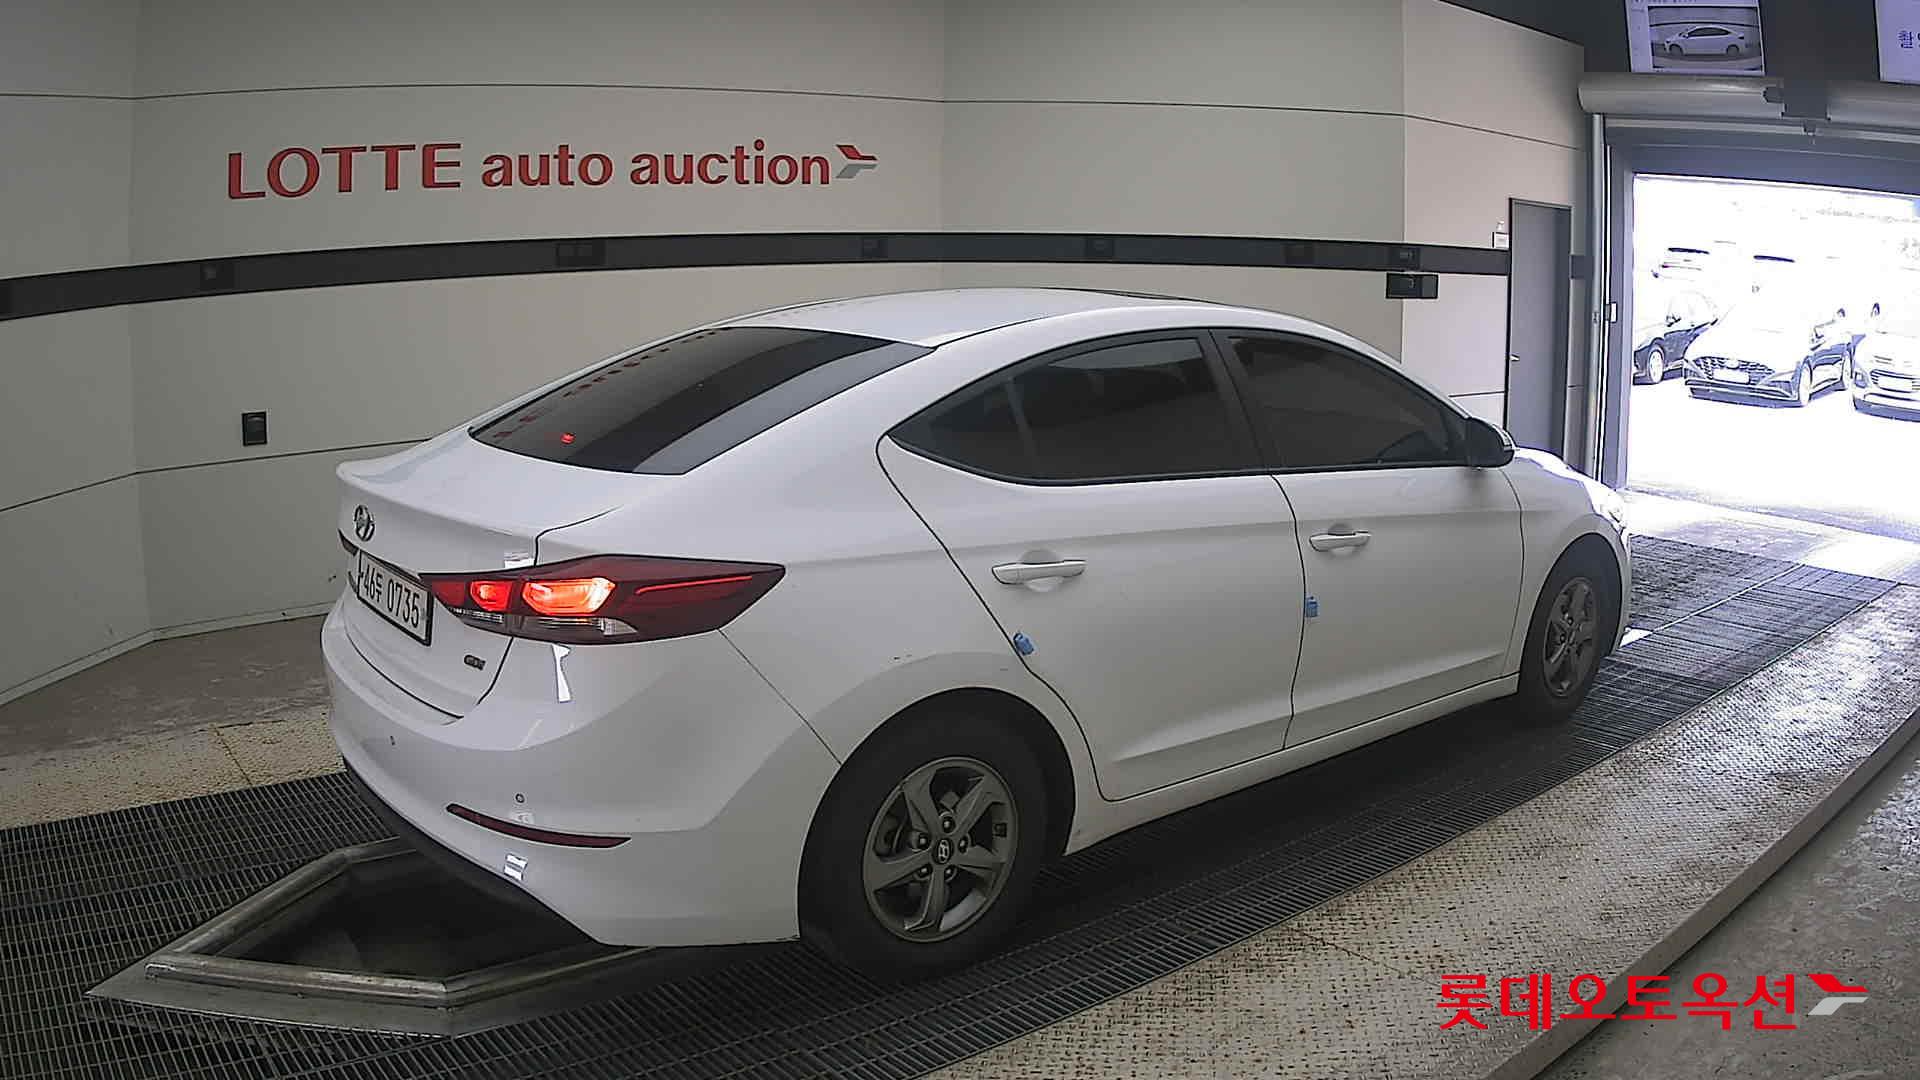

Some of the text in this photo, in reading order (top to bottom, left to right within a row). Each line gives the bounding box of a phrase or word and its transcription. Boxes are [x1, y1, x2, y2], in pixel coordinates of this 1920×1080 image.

[227, 139, 831, 200] LOTTE auto auction
[387, 578, 420, 629] 0735
